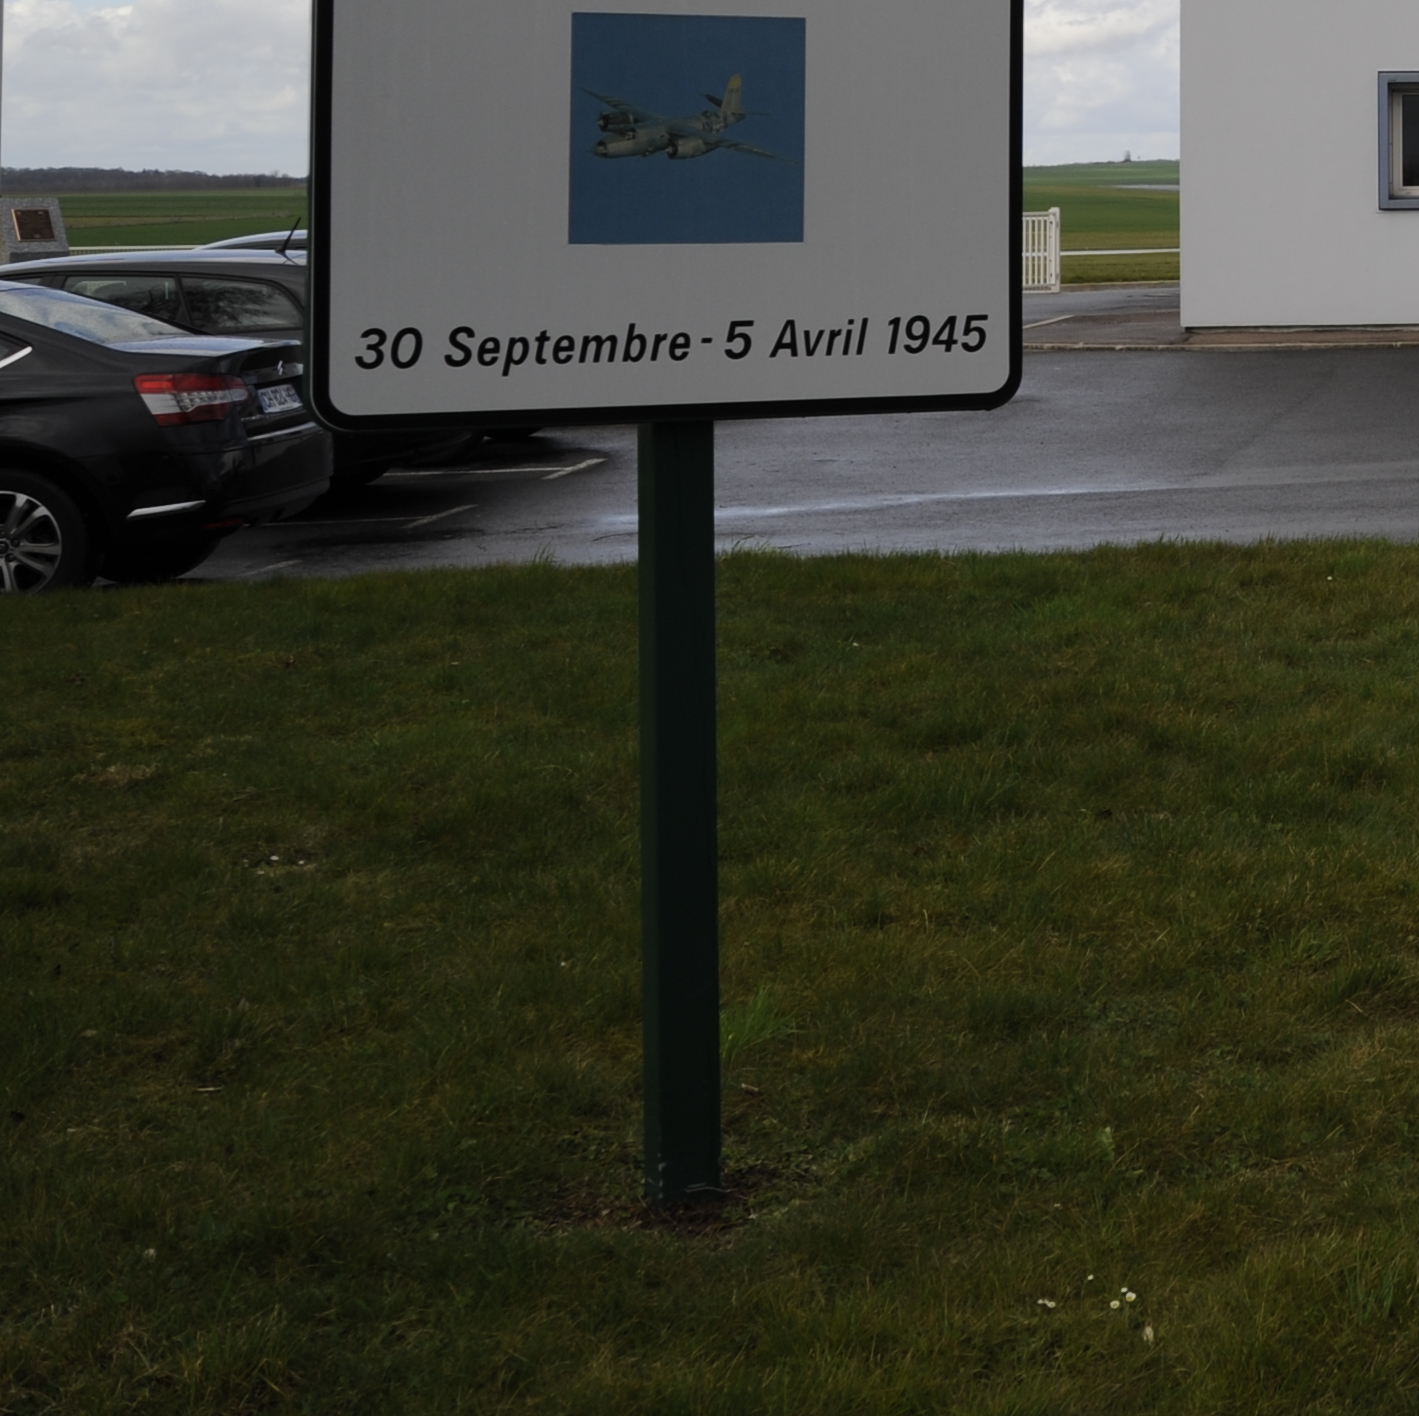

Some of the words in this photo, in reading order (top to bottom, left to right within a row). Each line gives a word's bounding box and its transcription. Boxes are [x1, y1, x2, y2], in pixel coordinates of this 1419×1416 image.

[354, 326, 423, 370] 30
[769, 317, 869, 359] Avril
[887, 314, 989, 355] 1945
